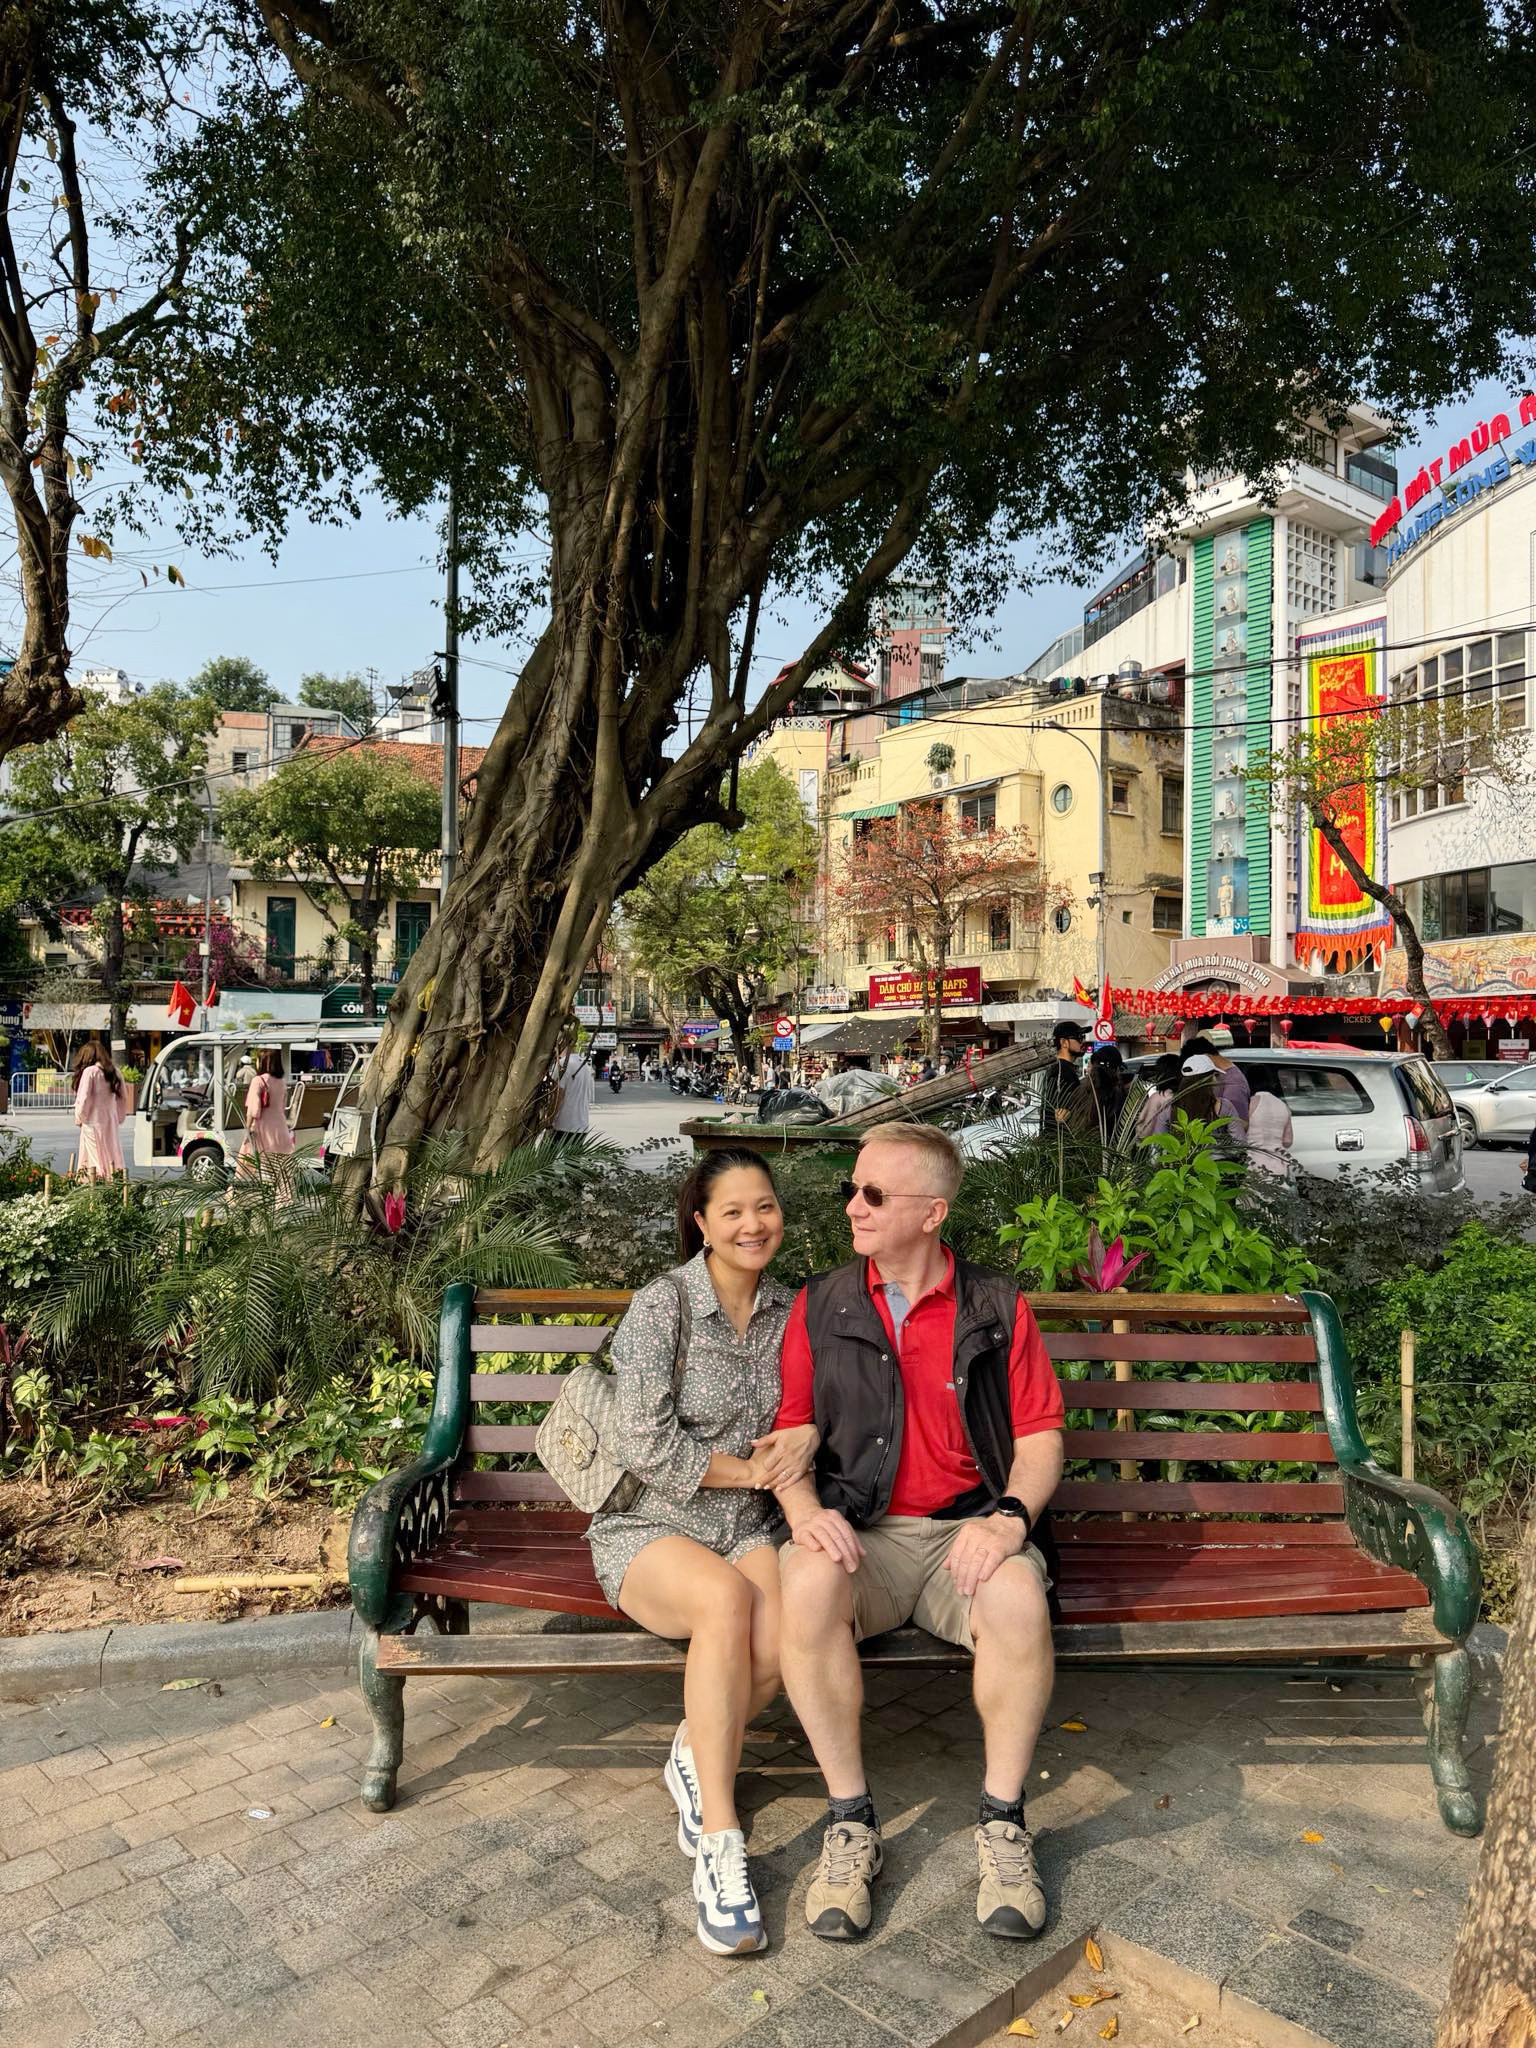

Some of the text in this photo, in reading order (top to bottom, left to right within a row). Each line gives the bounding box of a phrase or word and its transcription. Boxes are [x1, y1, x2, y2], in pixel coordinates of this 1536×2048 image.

[1449, 413, 1511, 475] MÚA
[1441, 457, 1511, 517] LONG
[1195, 969, 1215, 979] WATER
[1215, 969, 1236, 980] PUPPET
[1248, 967, 1271, 988] LONG
[341, 1002, 365, 1014] CÔN
[1343, 1015, 1373, 1024] TICKETS
